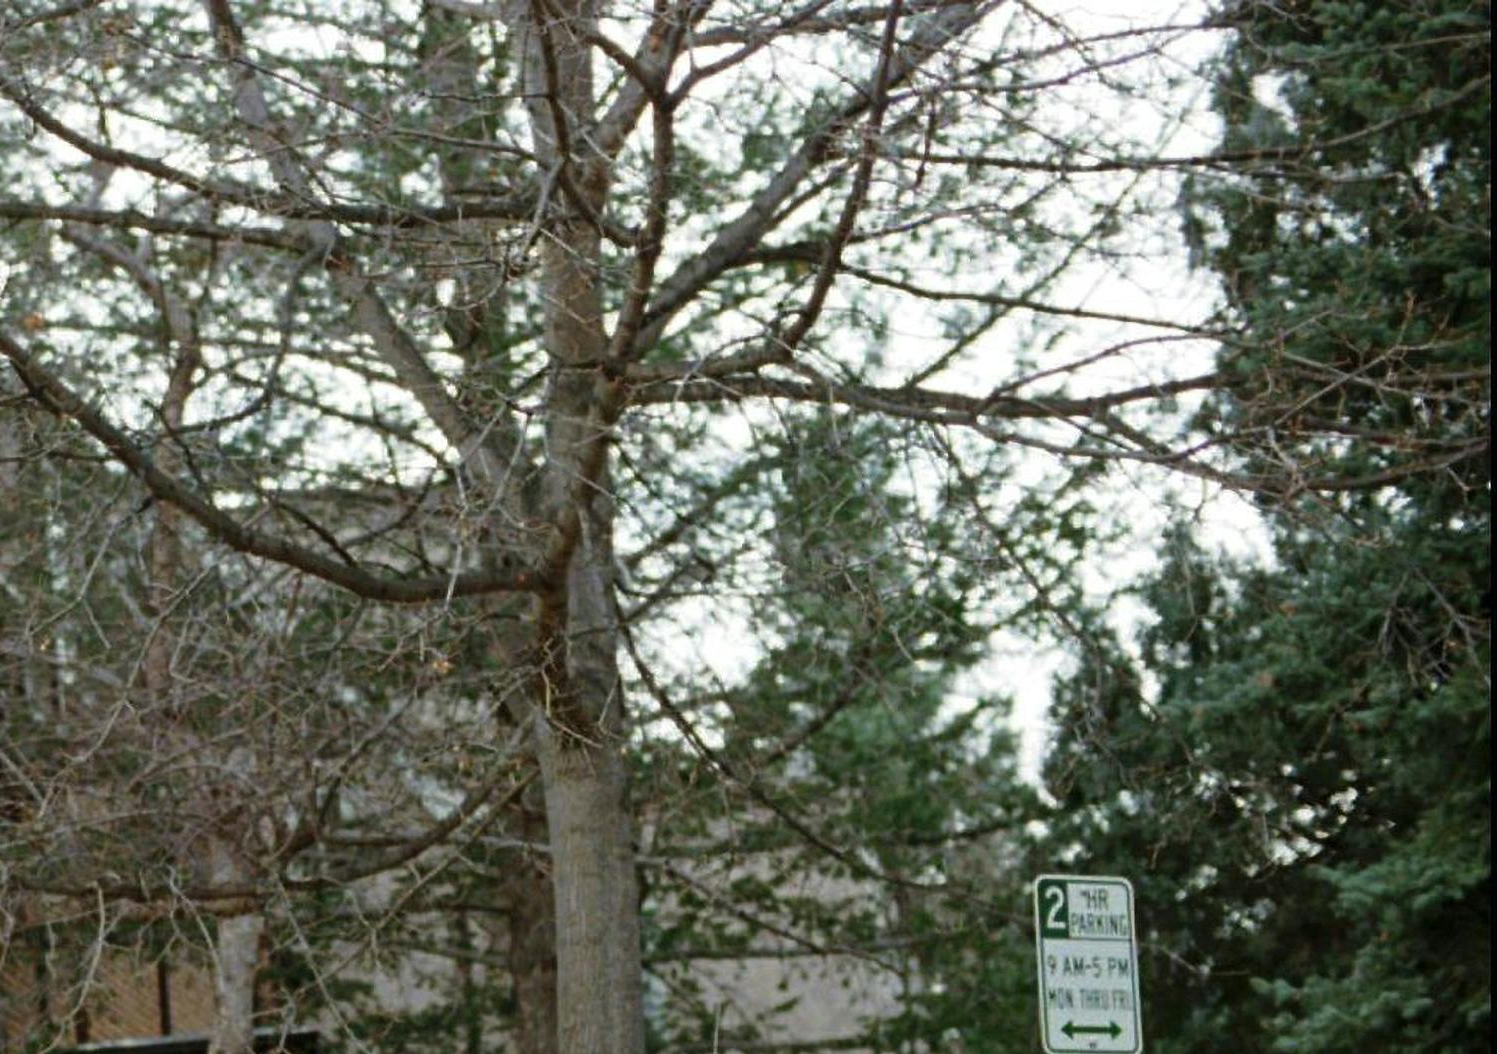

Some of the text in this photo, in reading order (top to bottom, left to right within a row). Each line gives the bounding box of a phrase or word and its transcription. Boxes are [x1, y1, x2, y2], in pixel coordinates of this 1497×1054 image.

[1045, 886, 1065, 929] 2
[1070, 912, 1128, 937] PARKING
[1064, 955, 1101, 978] AM-5
[1108, 956, 1129, 977] PM
[1048, 987, 1074, 1010] MON
